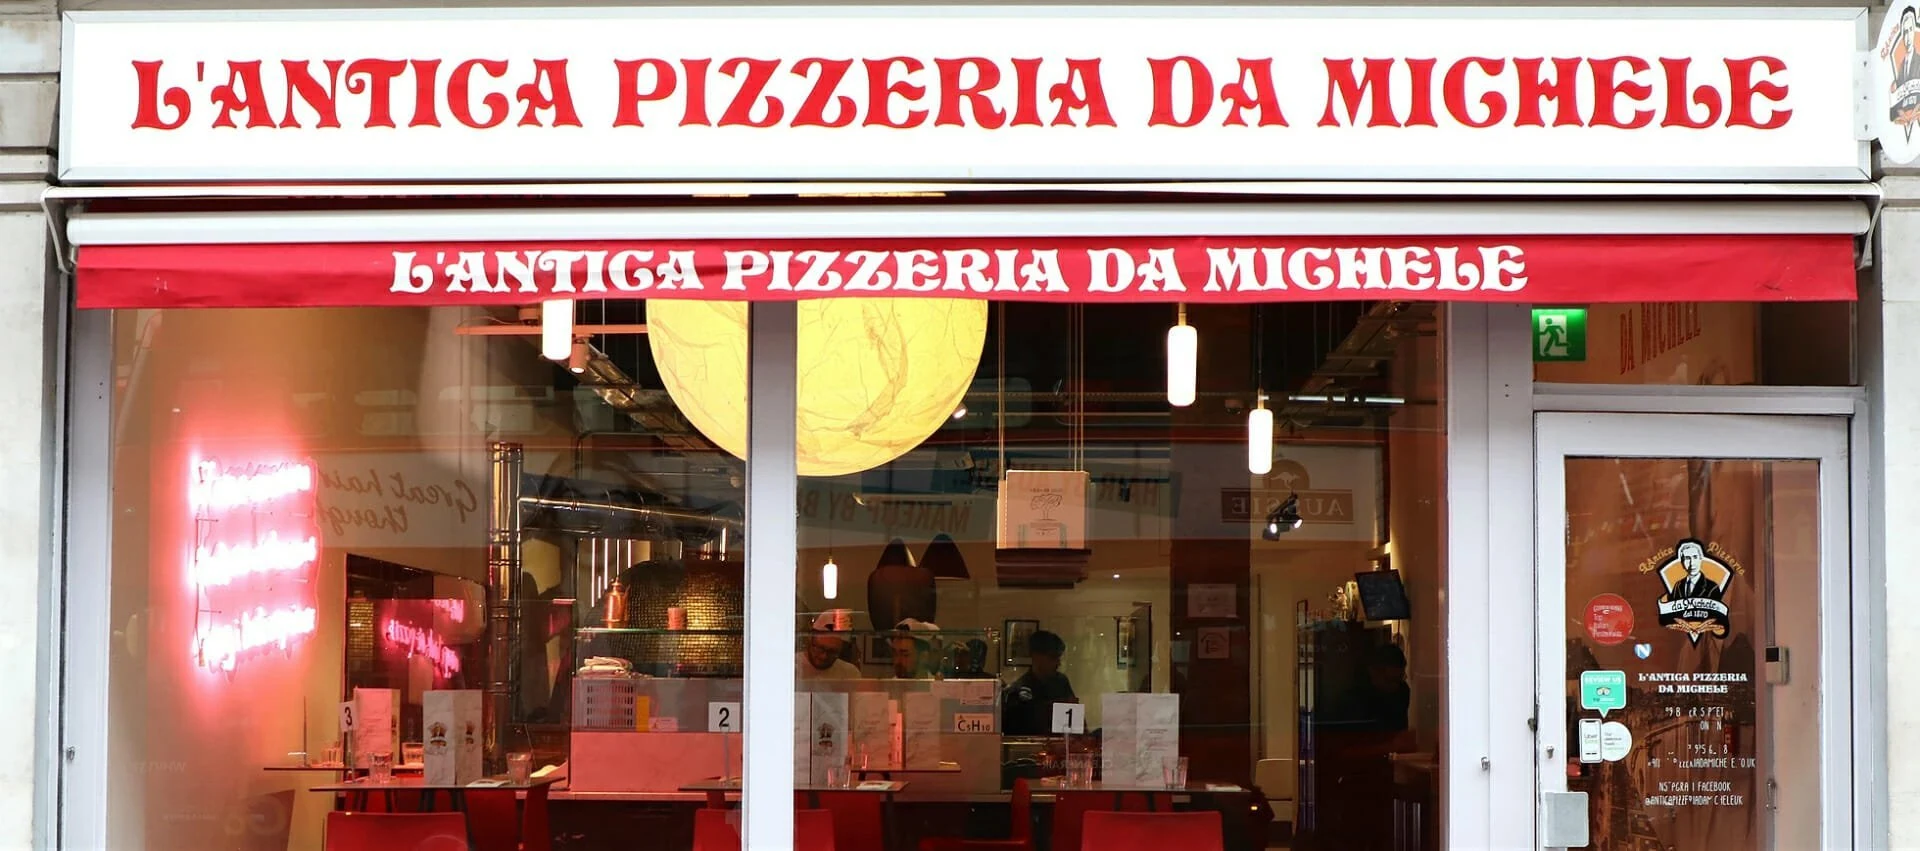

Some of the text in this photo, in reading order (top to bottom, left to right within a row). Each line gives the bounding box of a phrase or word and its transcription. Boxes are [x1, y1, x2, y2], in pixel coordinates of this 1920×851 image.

[131, 56, 1792, 130] L'ANTICA PIZZERIA DA MICHELE
[390, 247, 1527, 293] L'ANTICA PIZZERIA DA MICHELE
[1638, 673, 1748, 682] L'ANTICA PIZZERIA
[1658, 684, 1729, 694] DA MICHELE
[345, 706, 353, 725] 3
[718, 707, 730, 727] 2
[1065, 707, 1074, 728] 1
[1697, 781, 1732, 792] FACEBOOK
